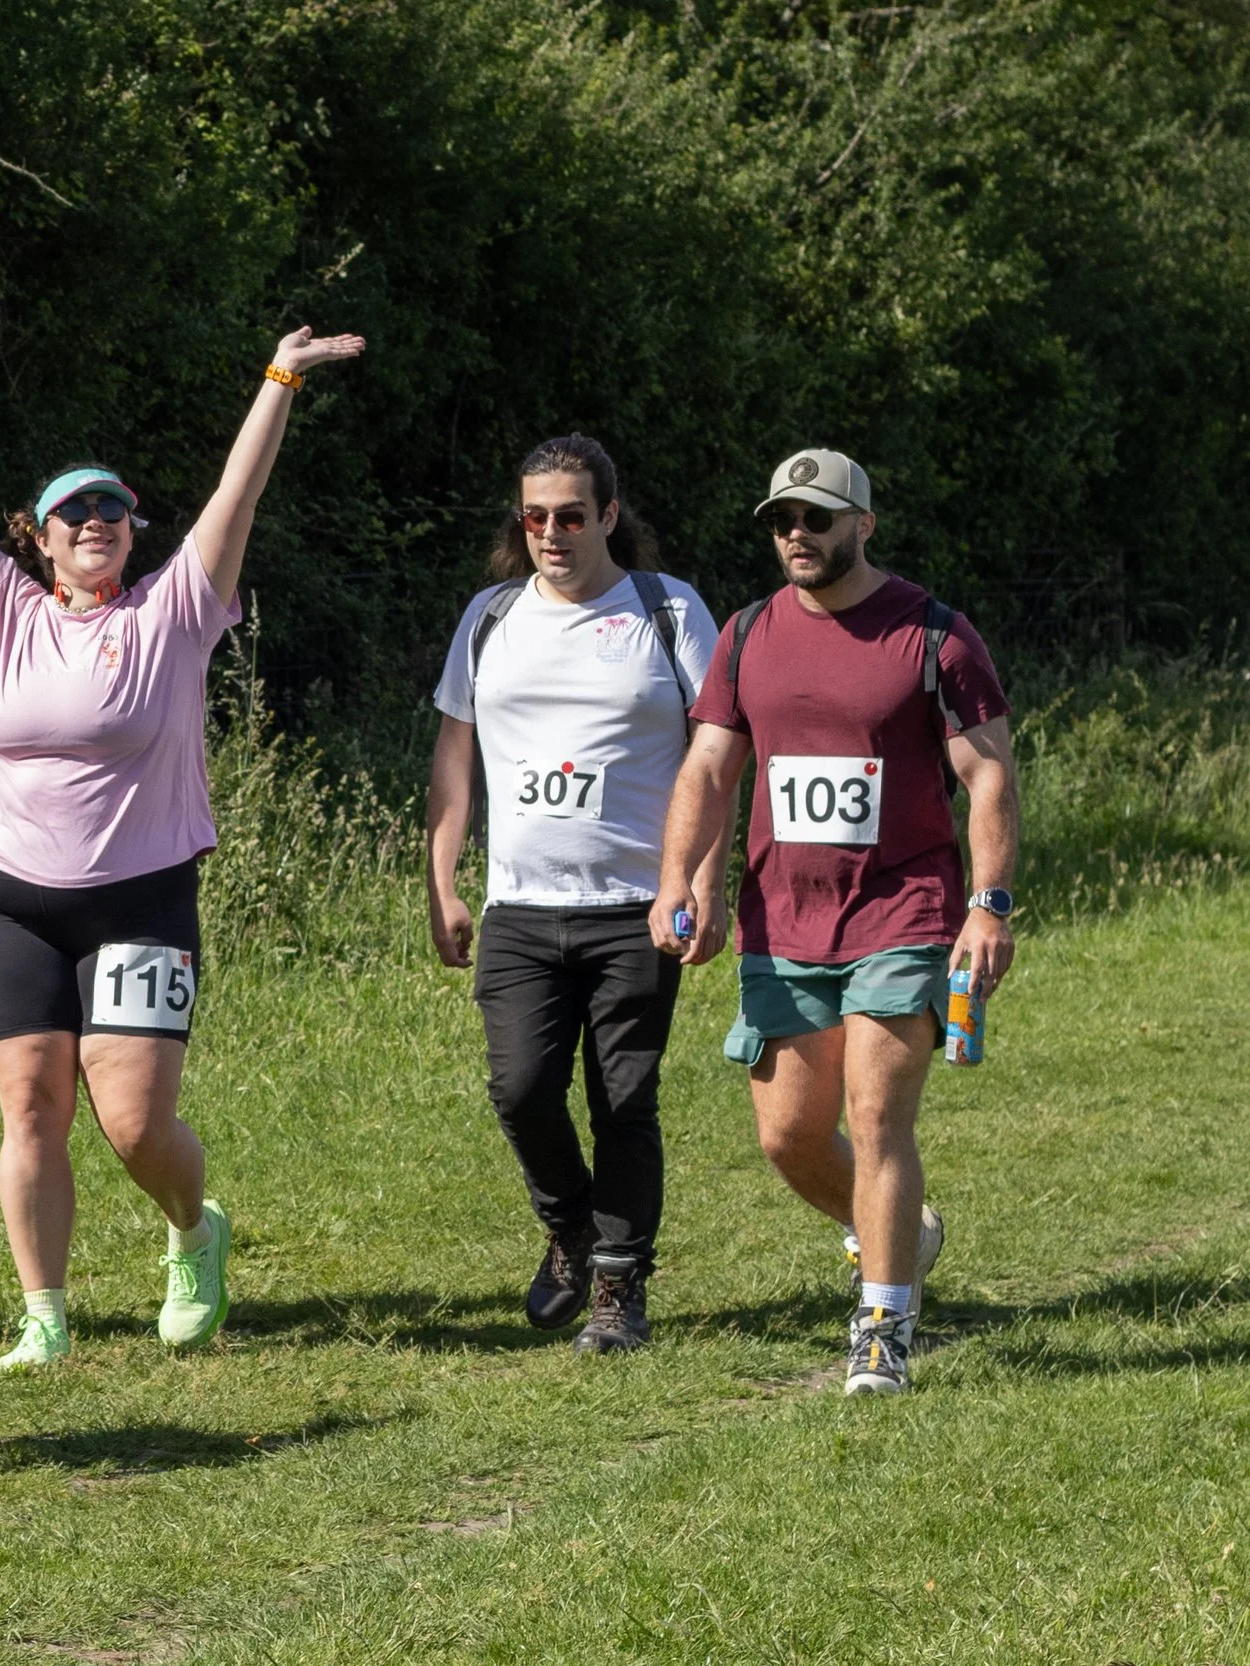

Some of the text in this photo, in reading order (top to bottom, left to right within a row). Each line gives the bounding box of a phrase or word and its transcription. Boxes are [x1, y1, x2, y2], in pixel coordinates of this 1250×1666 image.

[518, 769, 597, 808] 307
[779, 776, 871, 825] 103
[106, 963, 190, 1012] 115
